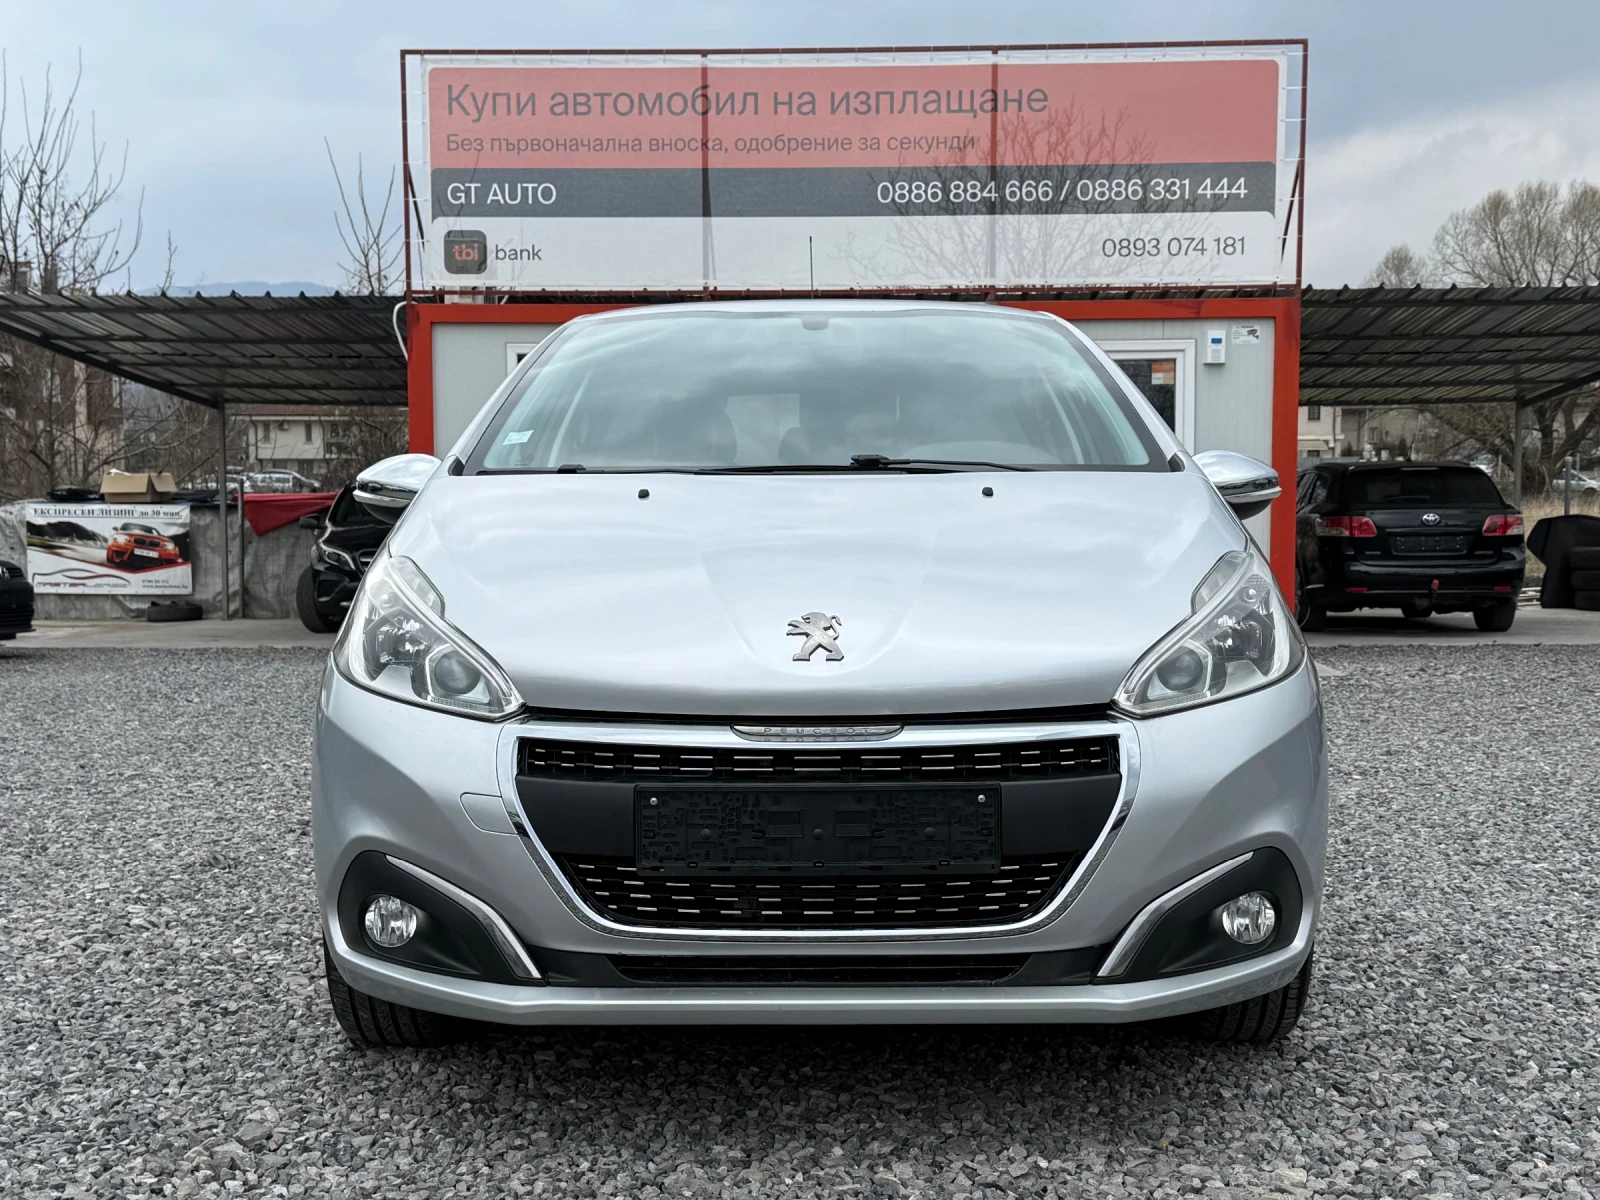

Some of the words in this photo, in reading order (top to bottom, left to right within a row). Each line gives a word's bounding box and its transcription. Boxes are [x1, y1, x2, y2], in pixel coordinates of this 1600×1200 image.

[446, 84, 536, 123] Купи
[549, 84, 760, 117] автомобил
[773, 91, 817, 116] на
[830, 87, 1049, 118] изплащане
[446, 134, 484, 152] Без
[491, 136, 643, 156] първоначална
[650, 136, 729, 155] вноска,
[735, 134, 853, 156] одобрение
[859, 137, 881, 151] за
[886, 135, 975, 155] секунди
[447, 183, 481, 205] GT
[487, 183, 557, 205] AUTO
[877, 182, 942, 203] 0886
[949, 181, 998, 202] 884
[1005, 180, 1053, 202] 666
[1076, 179, 1142, 201] 0886
[1149, 178, 1191, 200] 331
[1197, 177, 1248, 200] 444
[452, 244, 479, 261] tbi
[495, 244, 542, 261] bank
[1101, 237, 1160, 257] 0893
[1167, 237, 1207, 257] 074
[1213, 236, 1246, 256] 181
[763, 727, 871, 735] PEUGEOT
